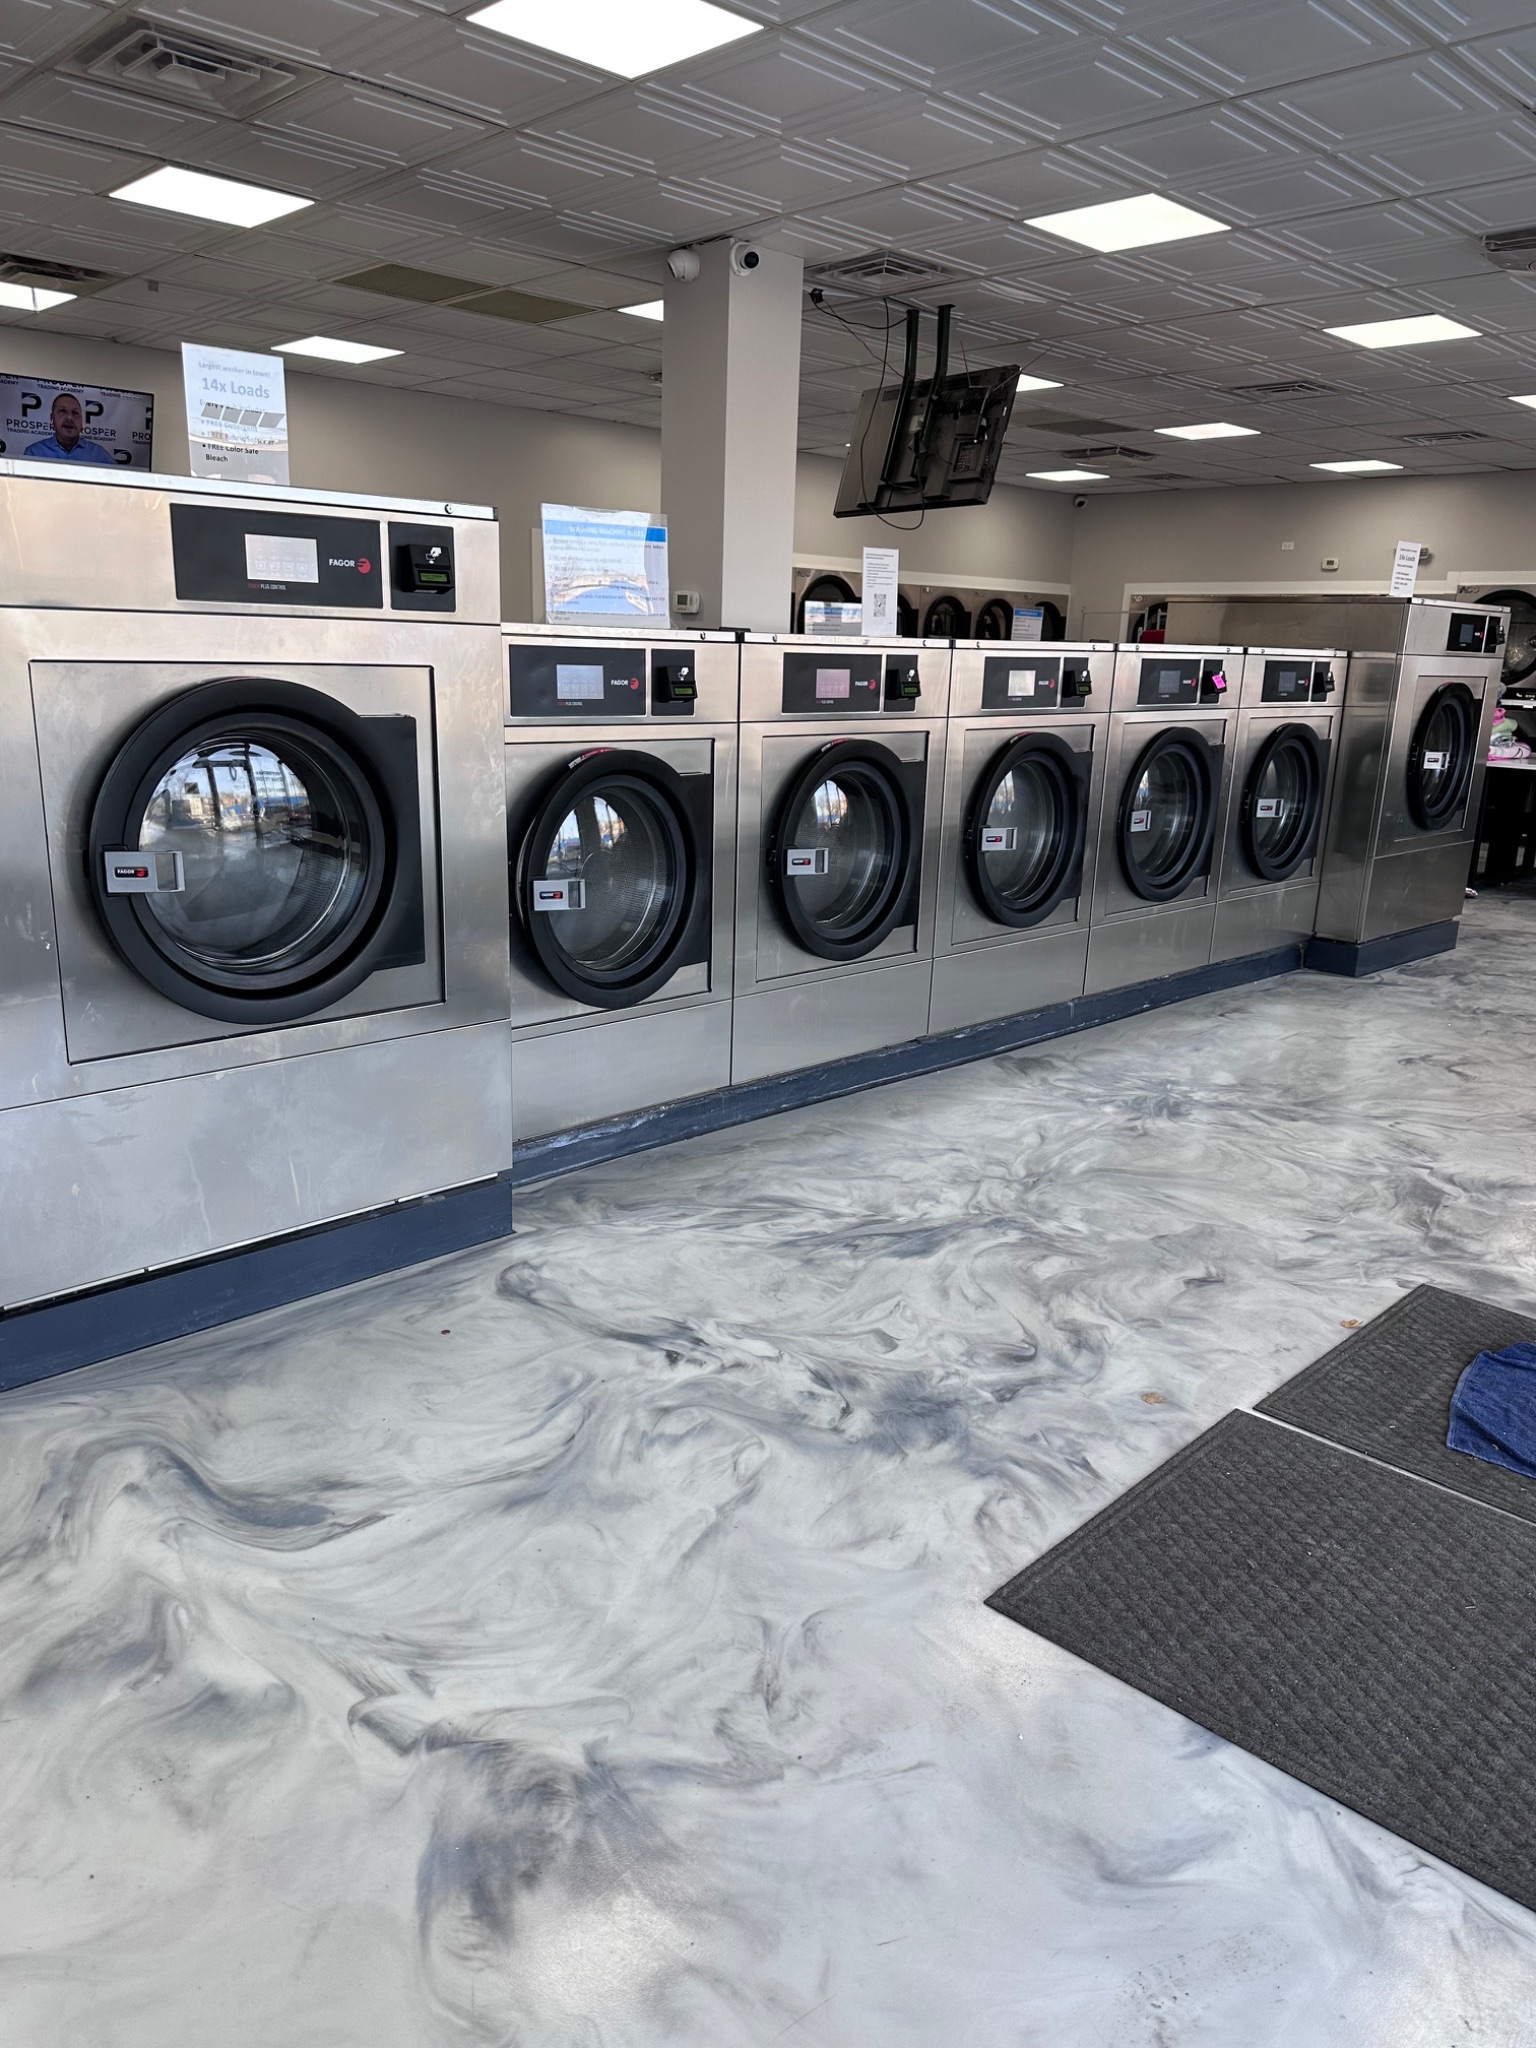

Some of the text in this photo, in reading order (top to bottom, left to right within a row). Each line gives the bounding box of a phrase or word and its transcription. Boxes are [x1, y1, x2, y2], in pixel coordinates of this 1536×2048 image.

[199, 361, 221, 370] Largest
[222, 366, 244, 374] washer
[202, 377, 270, 398] 14x Loads
[6, 418, 56, 431] PROSPER
[225, 445, 243, 453] Color
[245, 447, 259, 455] Safe
[206, 454, 228, 462] Bleach
[569, 526, 644, 537] WASHING MACHINE RULES
[329, 558, 355, 567] FAGOR
